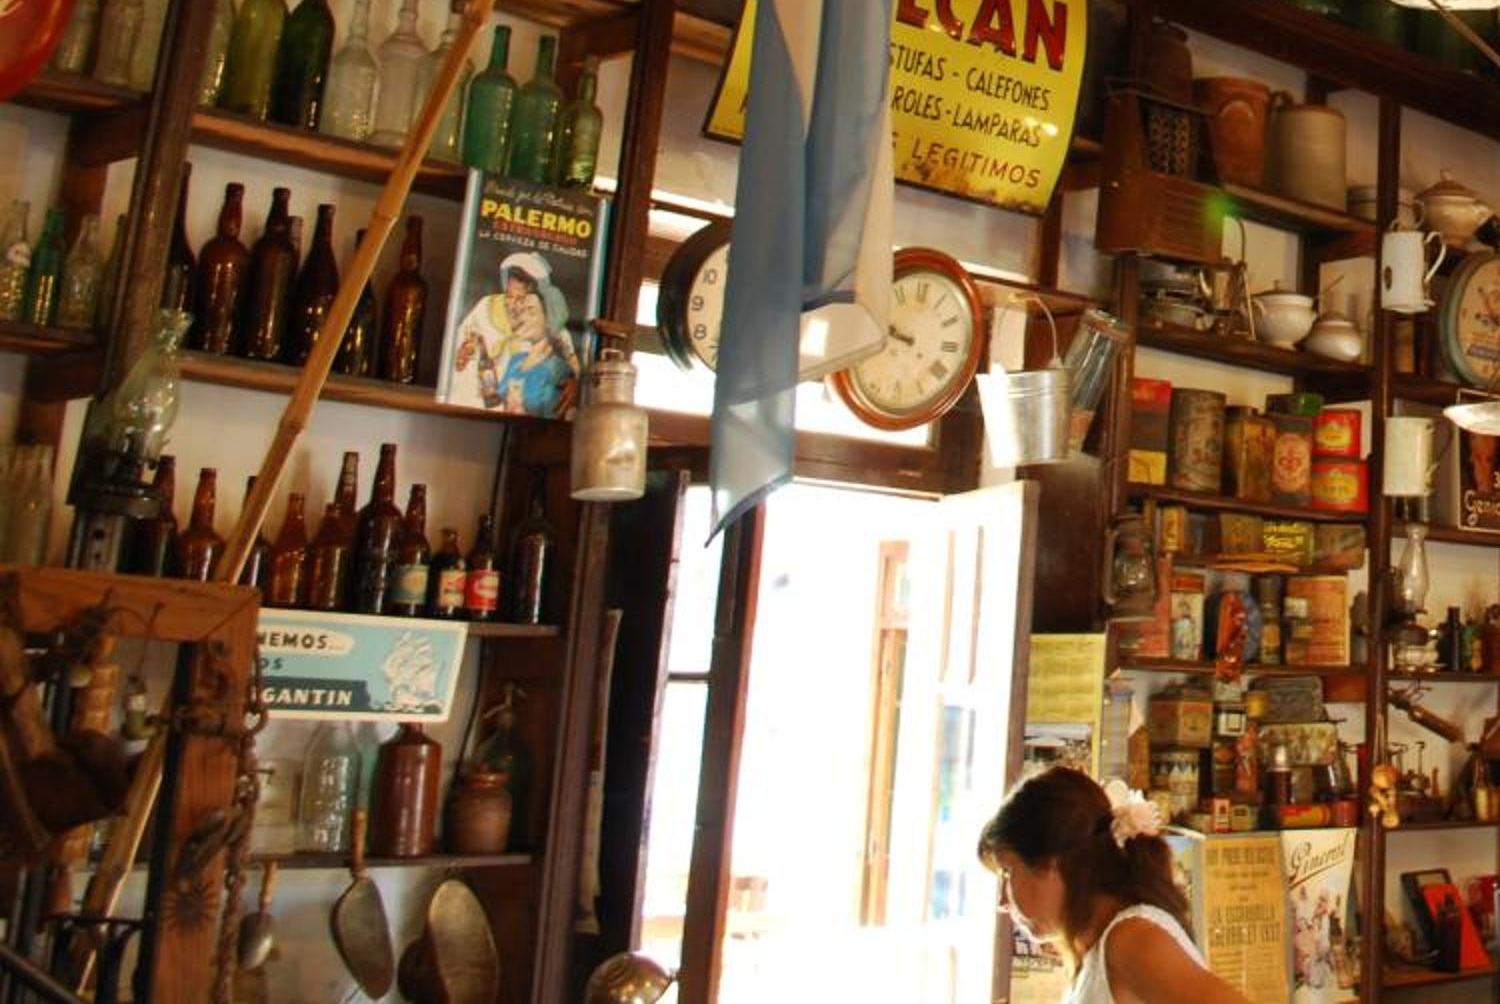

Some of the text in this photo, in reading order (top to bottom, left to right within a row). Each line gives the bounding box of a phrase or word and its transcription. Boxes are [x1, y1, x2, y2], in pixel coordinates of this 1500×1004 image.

[965, 67, 1051, 111] CALEFONES
[891, 85, 943, 121] ROLES
[952, 102, 1041, 147] LAMPARAS
[911, 137, 1041, 188] LEGITIMOS
[480, 199, 592, 238] PALERMO
[691, 295, 704, 311] 9
[693, 323, 707, 341] 8
[260, 687, 354, 706] GANTIN
